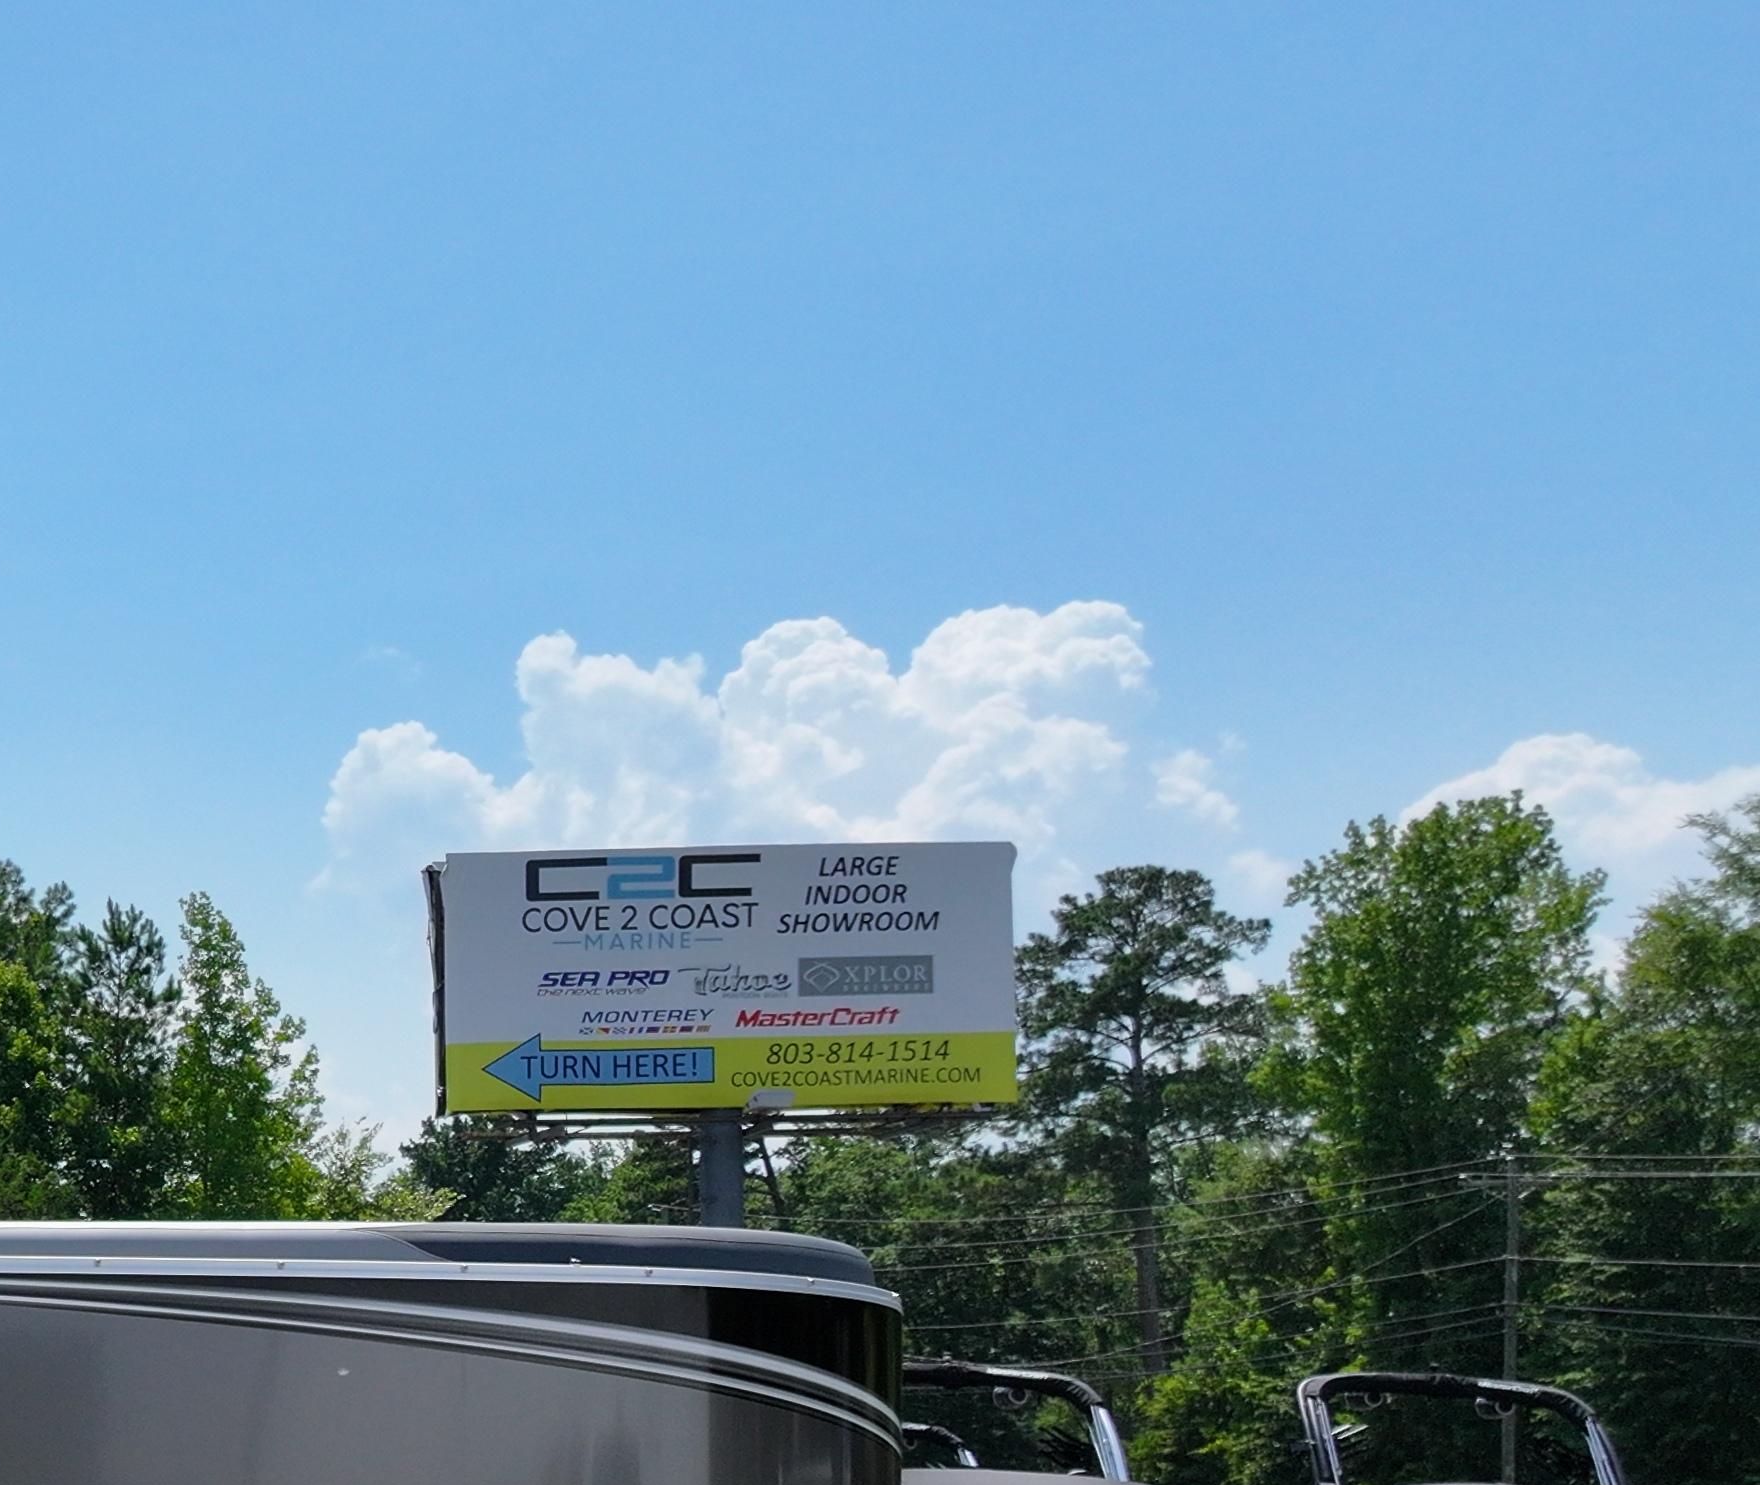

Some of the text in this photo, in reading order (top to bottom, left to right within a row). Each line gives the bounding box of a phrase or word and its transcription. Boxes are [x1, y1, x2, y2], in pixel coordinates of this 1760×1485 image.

[818, 855, 900, 877] LARGE
[525, 853, 761, 902] C2C
[804, 884, 908, 905] INDOOR
[521, 902, 759, 933] COVE 2 COAST
[776, 911, 940, 934] SHOWROOM
[584, 931, 692, 951] MARINE
[537, 969, 671, 988] SEA PRO
[678, 963, 792, 996] Tahoe
[843, 963, 928, 983] XPLOR
[564, 987, 602, 997] next
[581, 1008, 715, 1024] MONTEREY
[735, 1006, 901, 1028] MasterCraft
[766, 1039, 950, 1065] 803-814-1514
[520, 1052, 698, 1079] TURN HERE!
[731, 1066, 981, 1087] COVE2COASTMARINE.COM
